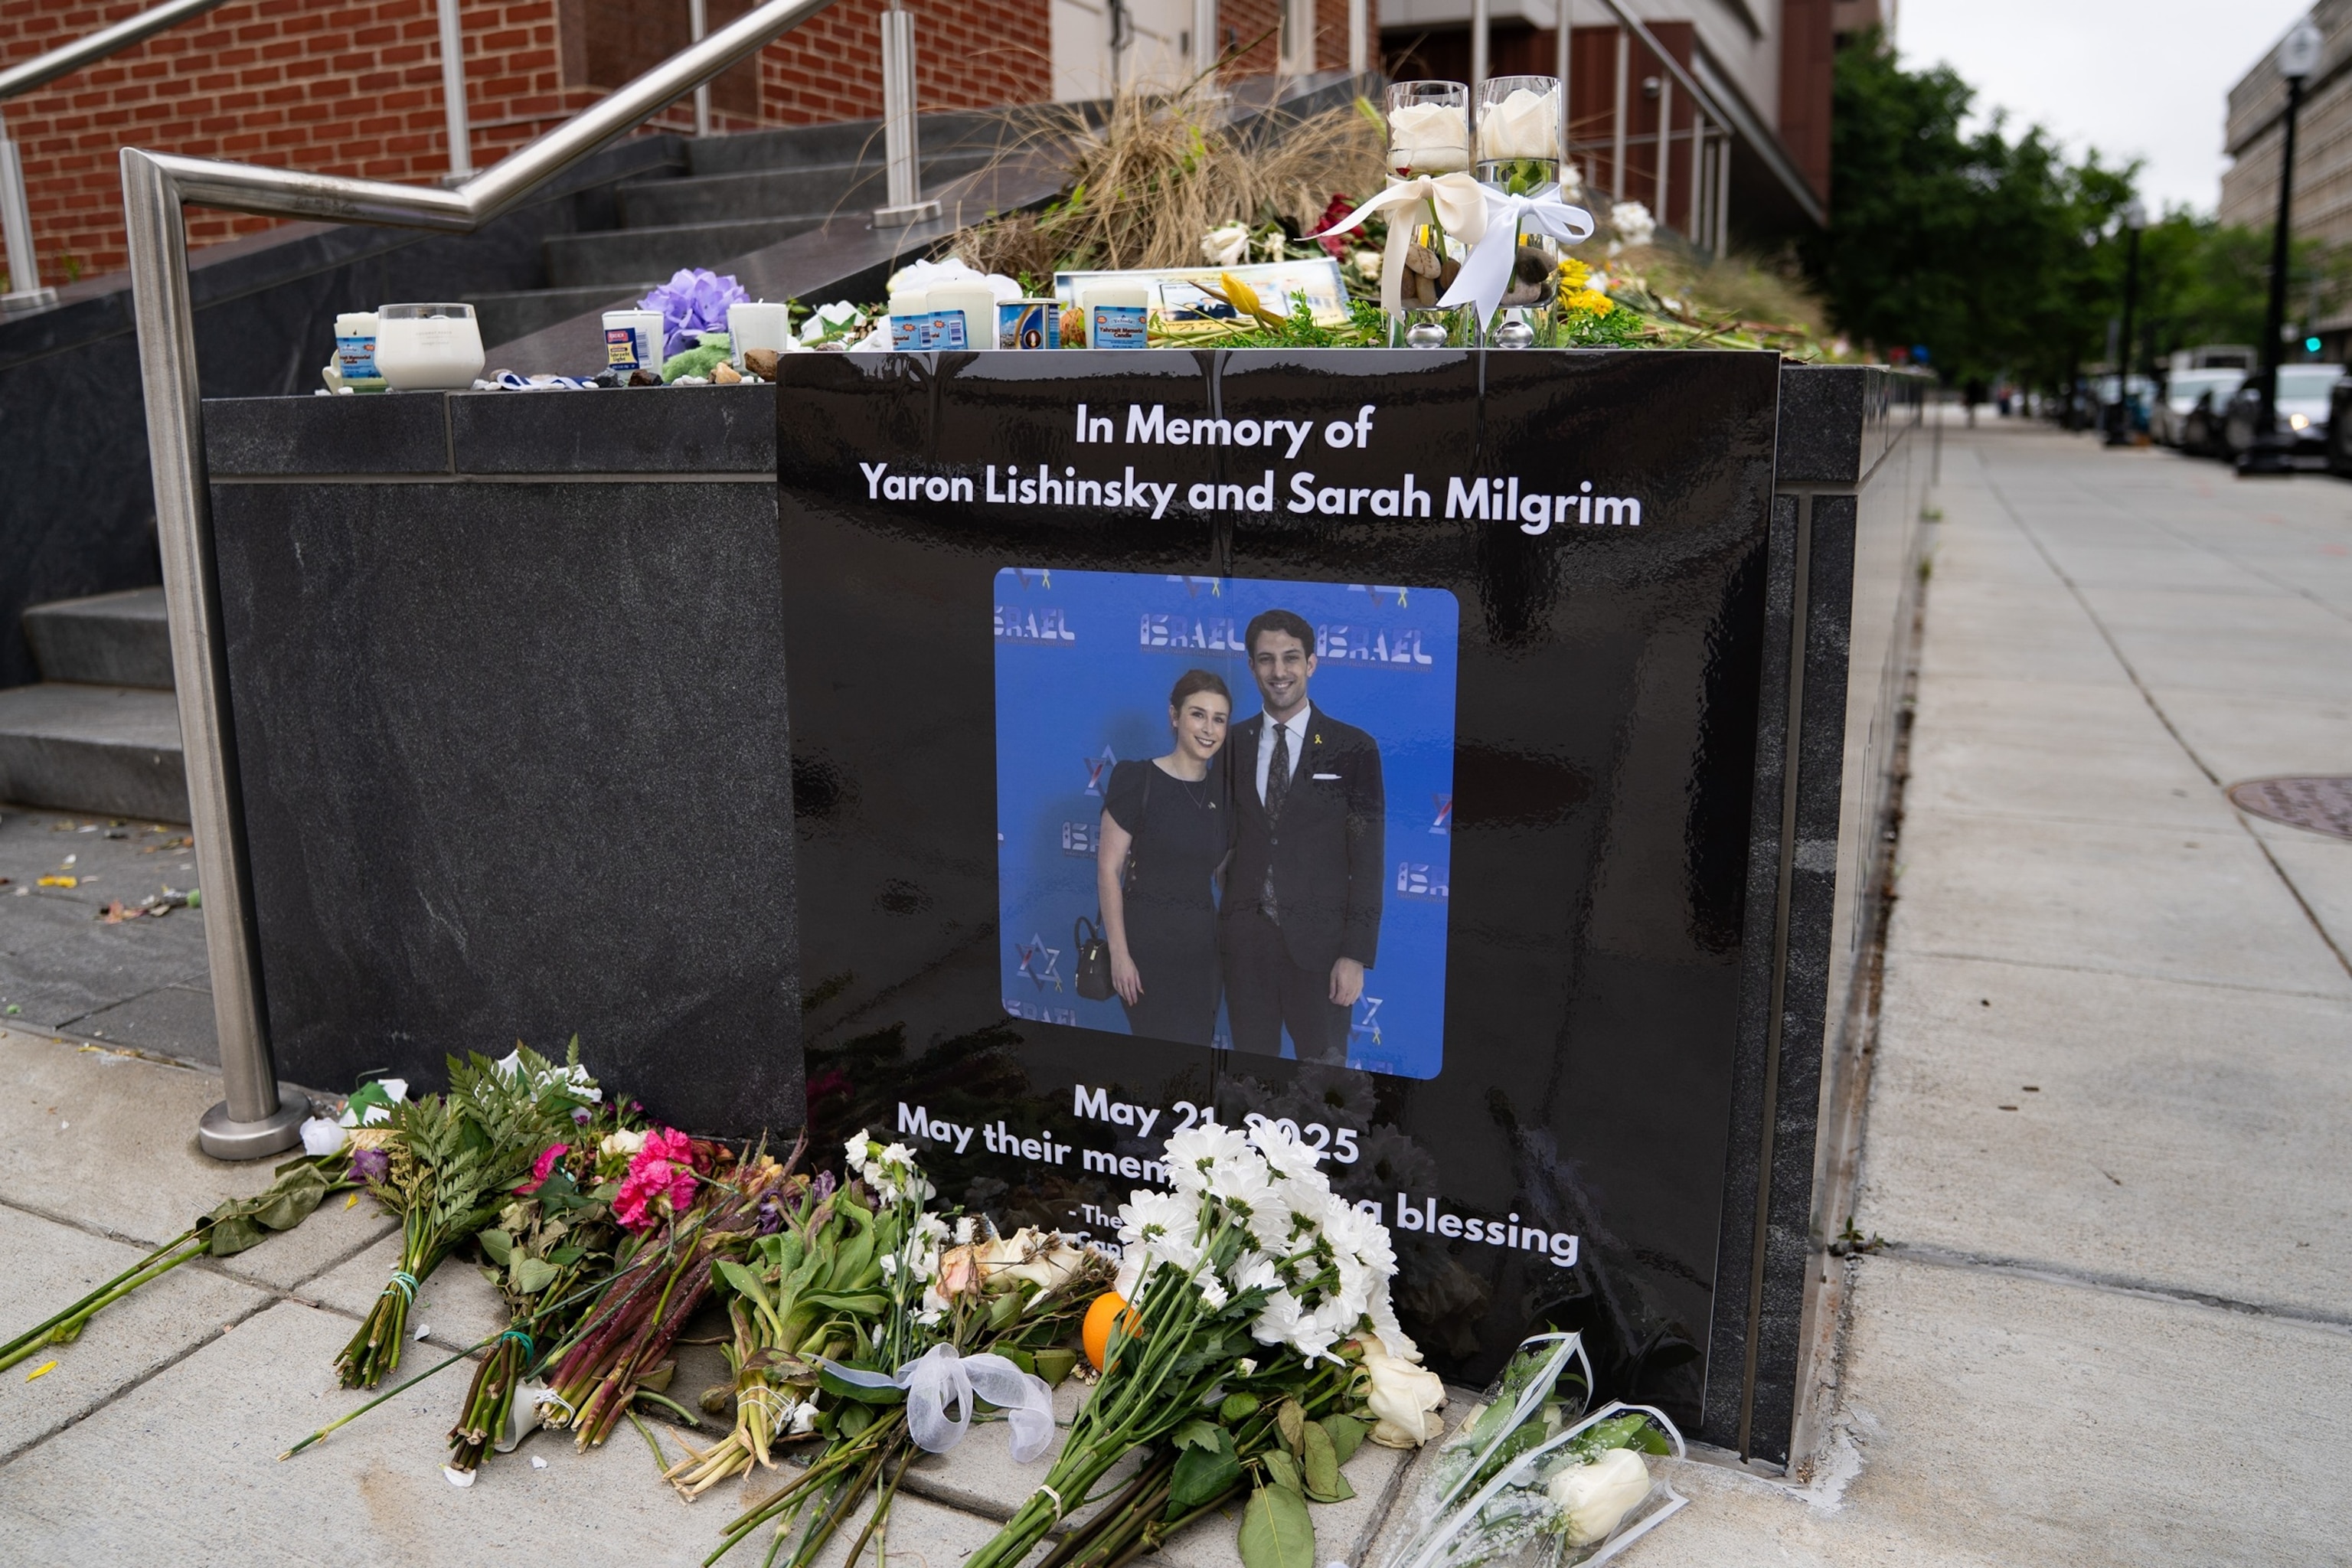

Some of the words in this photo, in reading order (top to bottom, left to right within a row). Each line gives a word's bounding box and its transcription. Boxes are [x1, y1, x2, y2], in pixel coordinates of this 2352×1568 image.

[1076, 403, 1113, 443] In
[1125, 404, 1314, 459] Memory
[1324, 404, 1376, 449] of
[859, 462, 974, 502] Yaron
[985, 463, 1178, 520] Lishinsky
[1187, 469, 1274, 512] and
[1287, 472, 1432, 518] Sarah
[1445, 476, 1642, 535] Milgrim
[1140, 613, 1246, 652] ISRAEL
[1316, 623, 1432, 665] ISRAEL
[1073, 1084, 1161, 1138] May
[897, 1102, 974, 1155] May
[983, 1120, 1072, 1165] their
[1396, 1192, 1579, 1268] blessing
[1080, 1203, 1123, 1230] The
